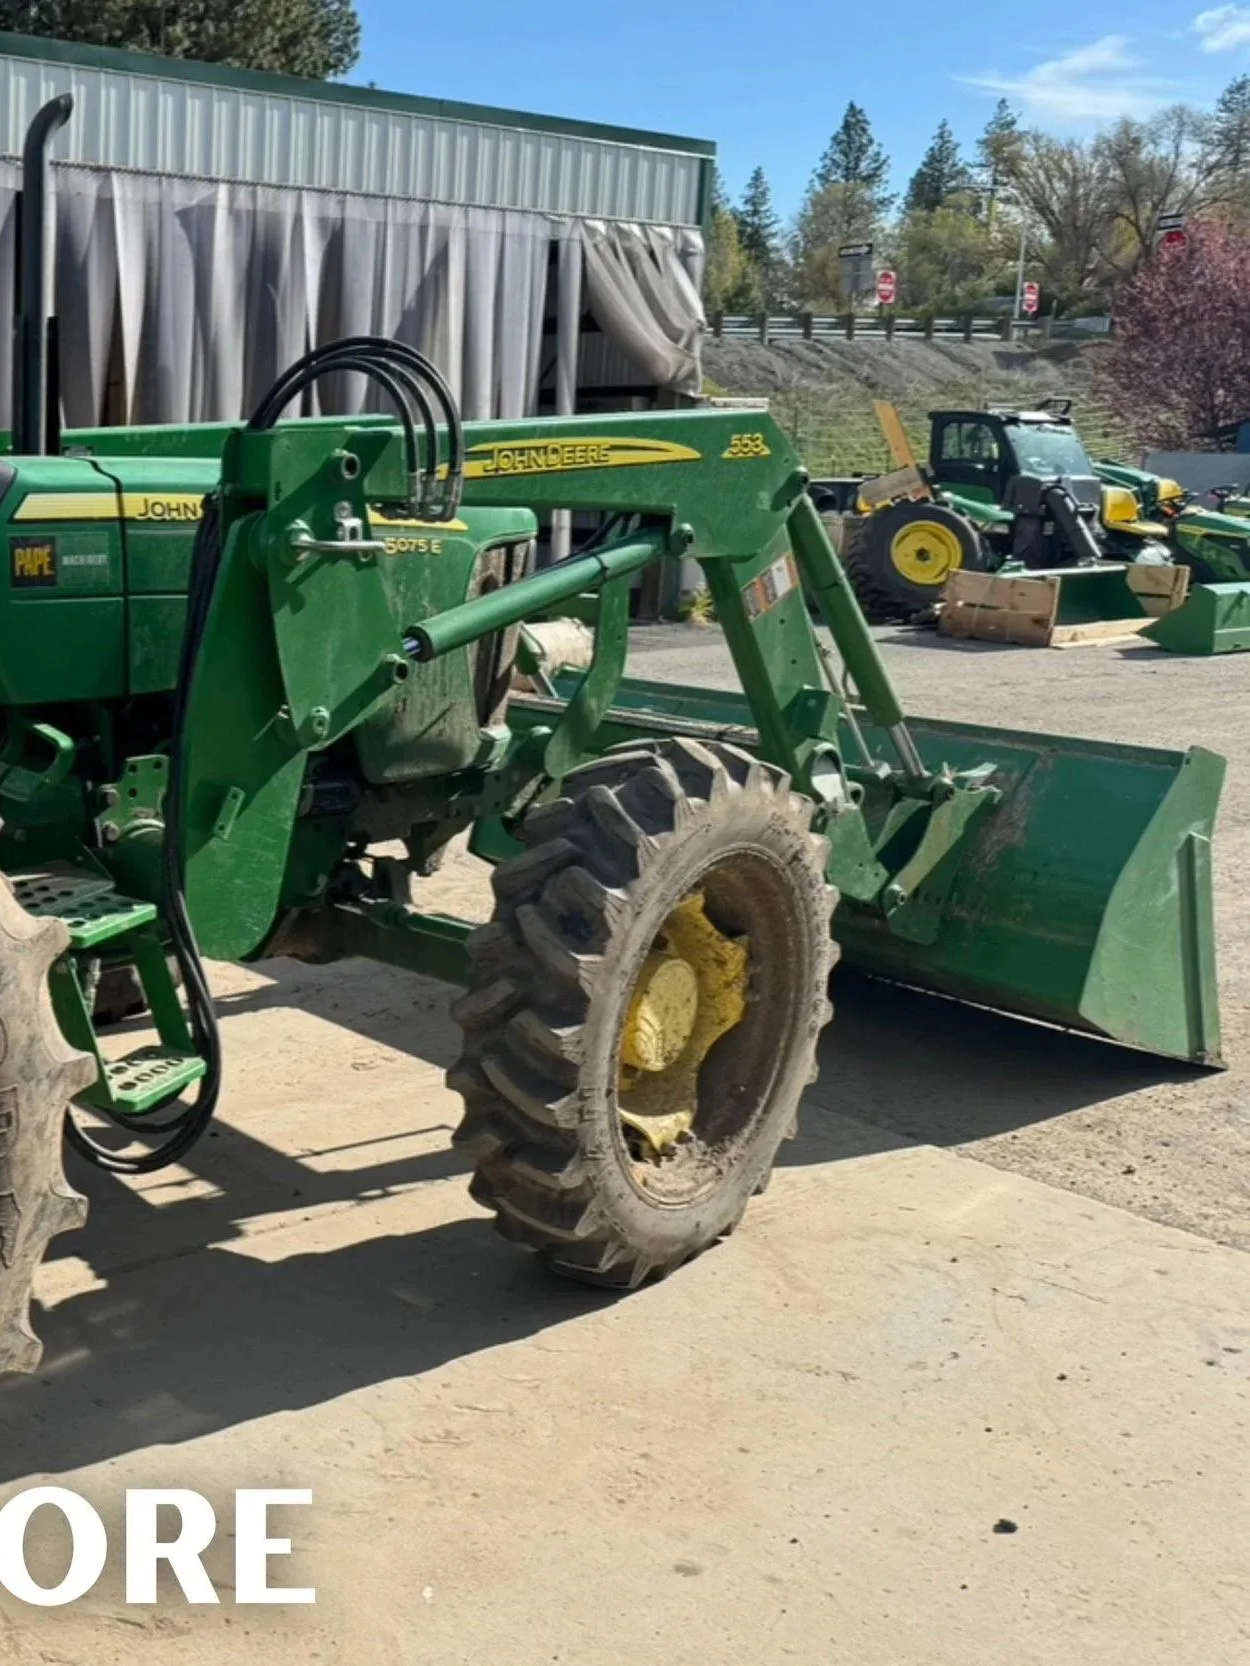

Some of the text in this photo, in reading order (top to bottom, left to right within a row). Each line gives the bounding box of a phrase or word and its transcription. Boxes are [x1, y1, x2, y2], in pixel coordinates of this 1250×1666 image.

[730, 432, 764, 456] 553
[484, 442, 610, 473] JOHN DEERE
[137, 497, 199, 520] JOHN
[385, 536, 442, 554] 5075 E
